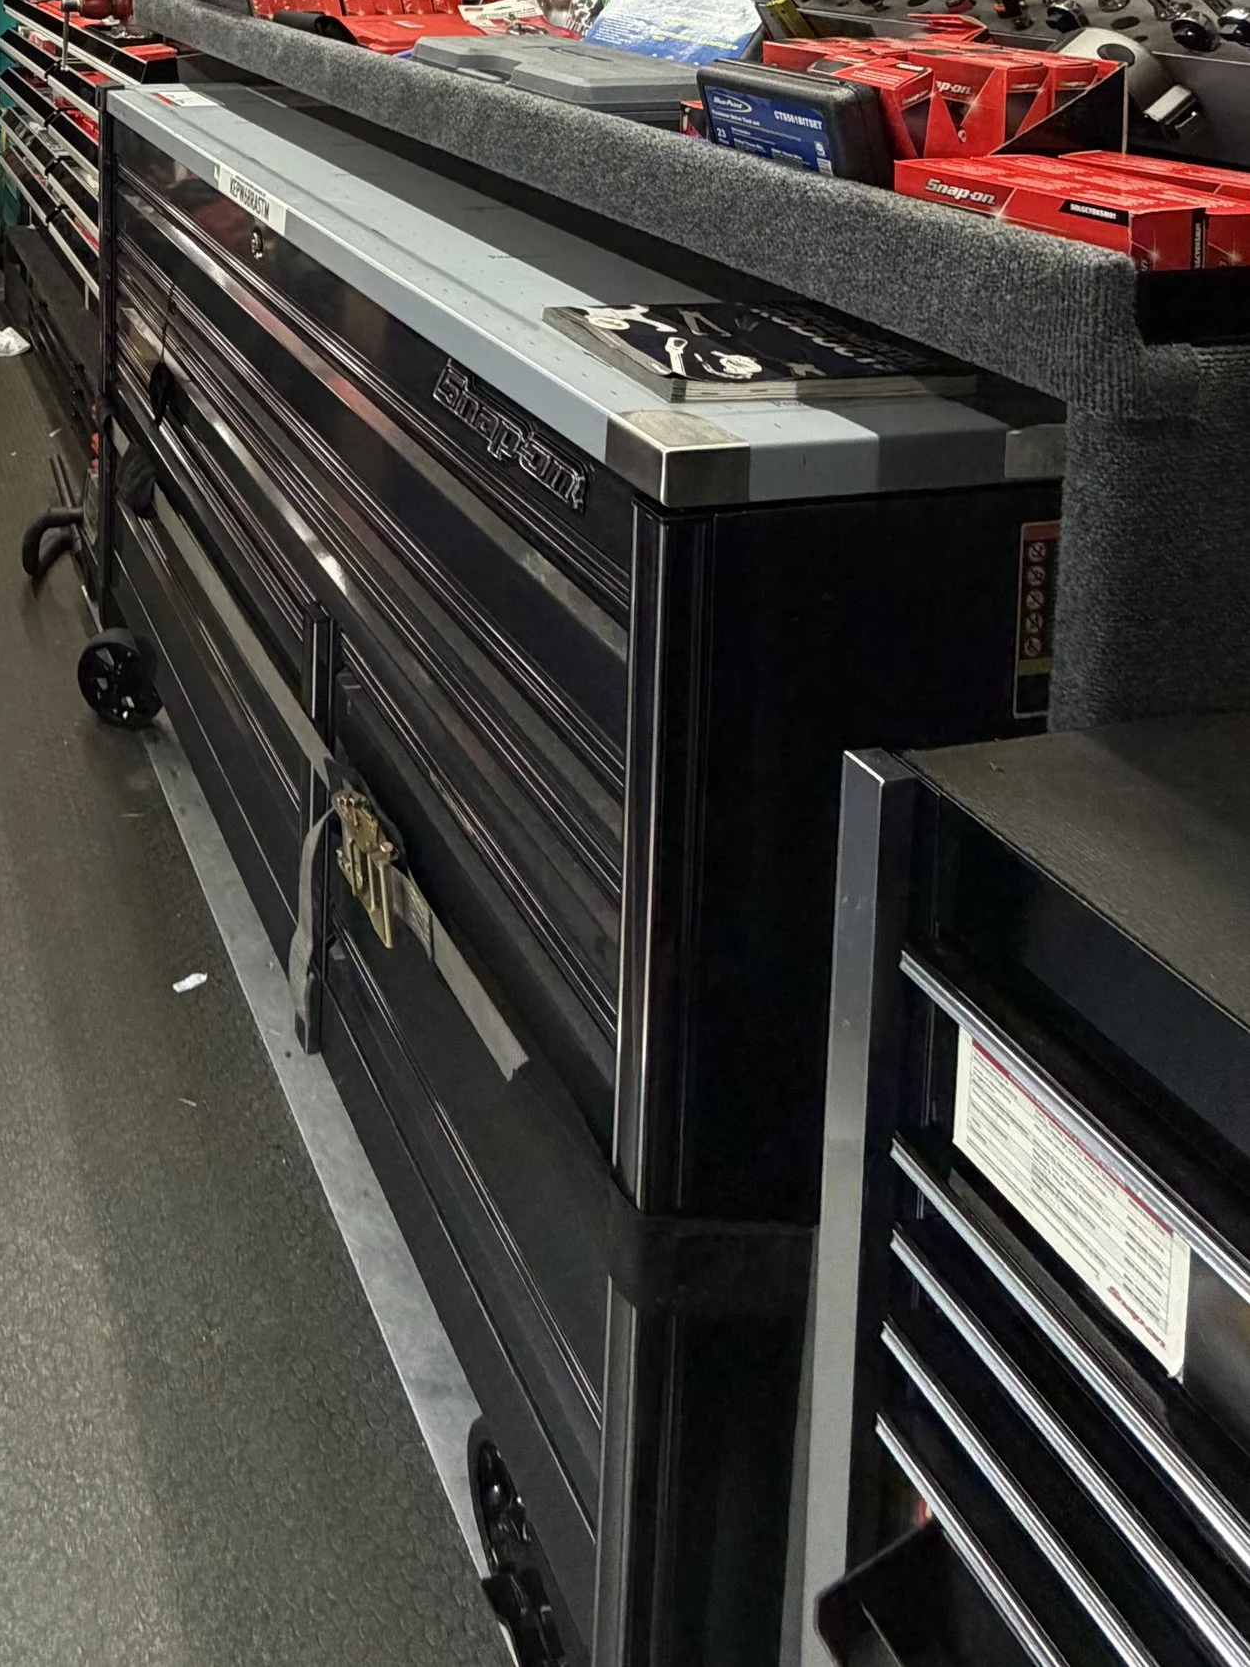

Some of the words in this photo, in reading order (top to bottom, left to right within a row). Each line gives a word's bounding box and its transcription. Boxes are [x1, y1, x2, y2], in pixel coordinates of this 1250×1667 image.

[925, 178, 997, 206] Snap-on
[433, 357, 586, 515] Snap-on
[1107, 1286, 1166, 1350] Snap-on
